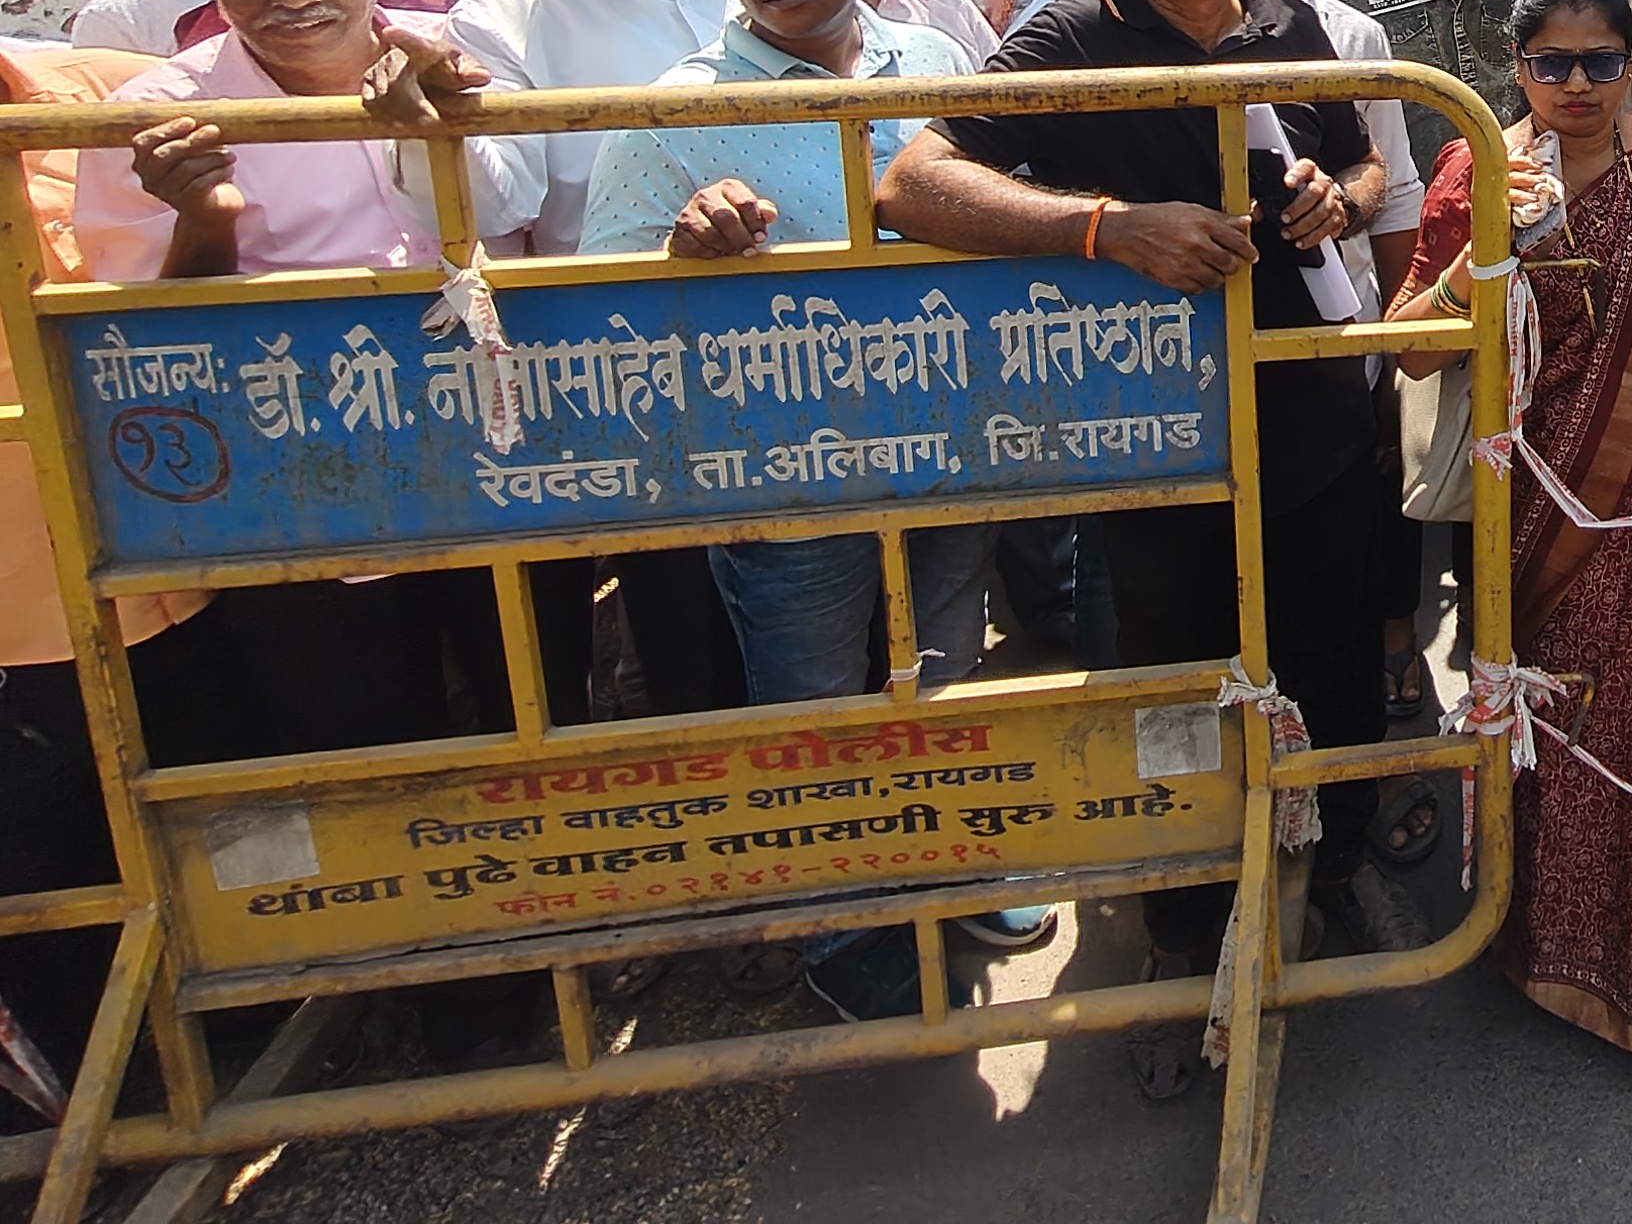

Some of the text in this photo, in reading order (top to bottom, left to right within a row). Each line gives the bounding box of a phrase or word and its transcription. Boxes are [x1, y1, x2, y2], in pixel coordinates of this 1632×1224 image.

[85, 323, 231, 402] सौजन्य:
[699, 288, 971, 406] धर्माधिकारी
[476, 449, 662, 505] रेवदंडा,
[475, 719, 993, 804] रायगड पोलीस
[247, 875, 405, 915] थांबा
[422, 854, 518, 899] पुढे
[527, 841, 688, 876] वाहन
[704, 803, 943, 856] तपासणी
[1073, 782, 1194, 821] आहे.
[405, 815, 545, 849] जिल्हा
[561, 794, 730, 830] वाहतुक
[493, 889, 578, 916] फोन
